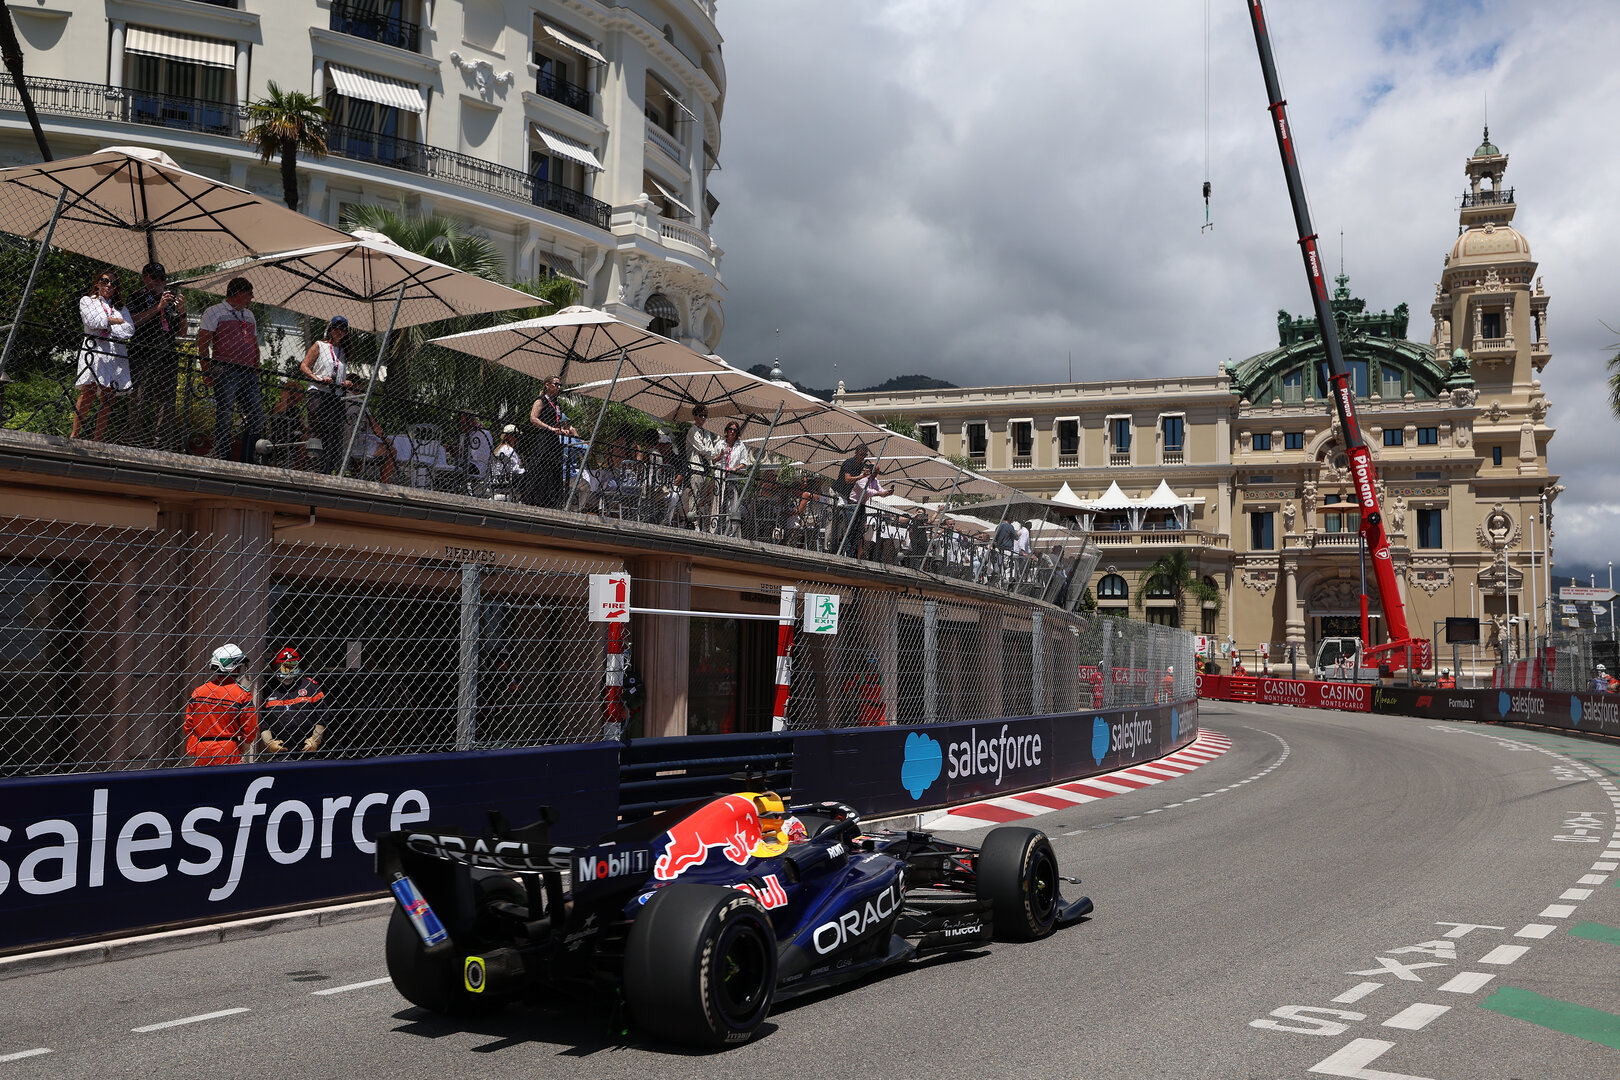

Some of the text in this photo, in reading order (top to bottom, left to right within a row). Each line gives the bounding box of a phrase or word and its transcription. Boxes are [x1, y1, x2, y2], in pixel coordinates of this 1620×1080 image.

[1354, 455, 1374, 508] Piovano
[1264, 681, 1306, 697] CASINO
[1321, 685, 1364, 702] CASINO
[1448, 699, 1470, 708] Formula
[1512, 691, 1545, 719] salesforce
[1583, 696, 1619, 729] salesforce
[1112, 712, 1152, 758] salesforce
[948, 724, 1042, 786] salesforce
[0, 776, 430, 901] alesforce
[406, 833, 575, 870] ORACLE
[578, 851, 630, 882] Mobil
[1248, 921, 1506, 1036] TAXIS
